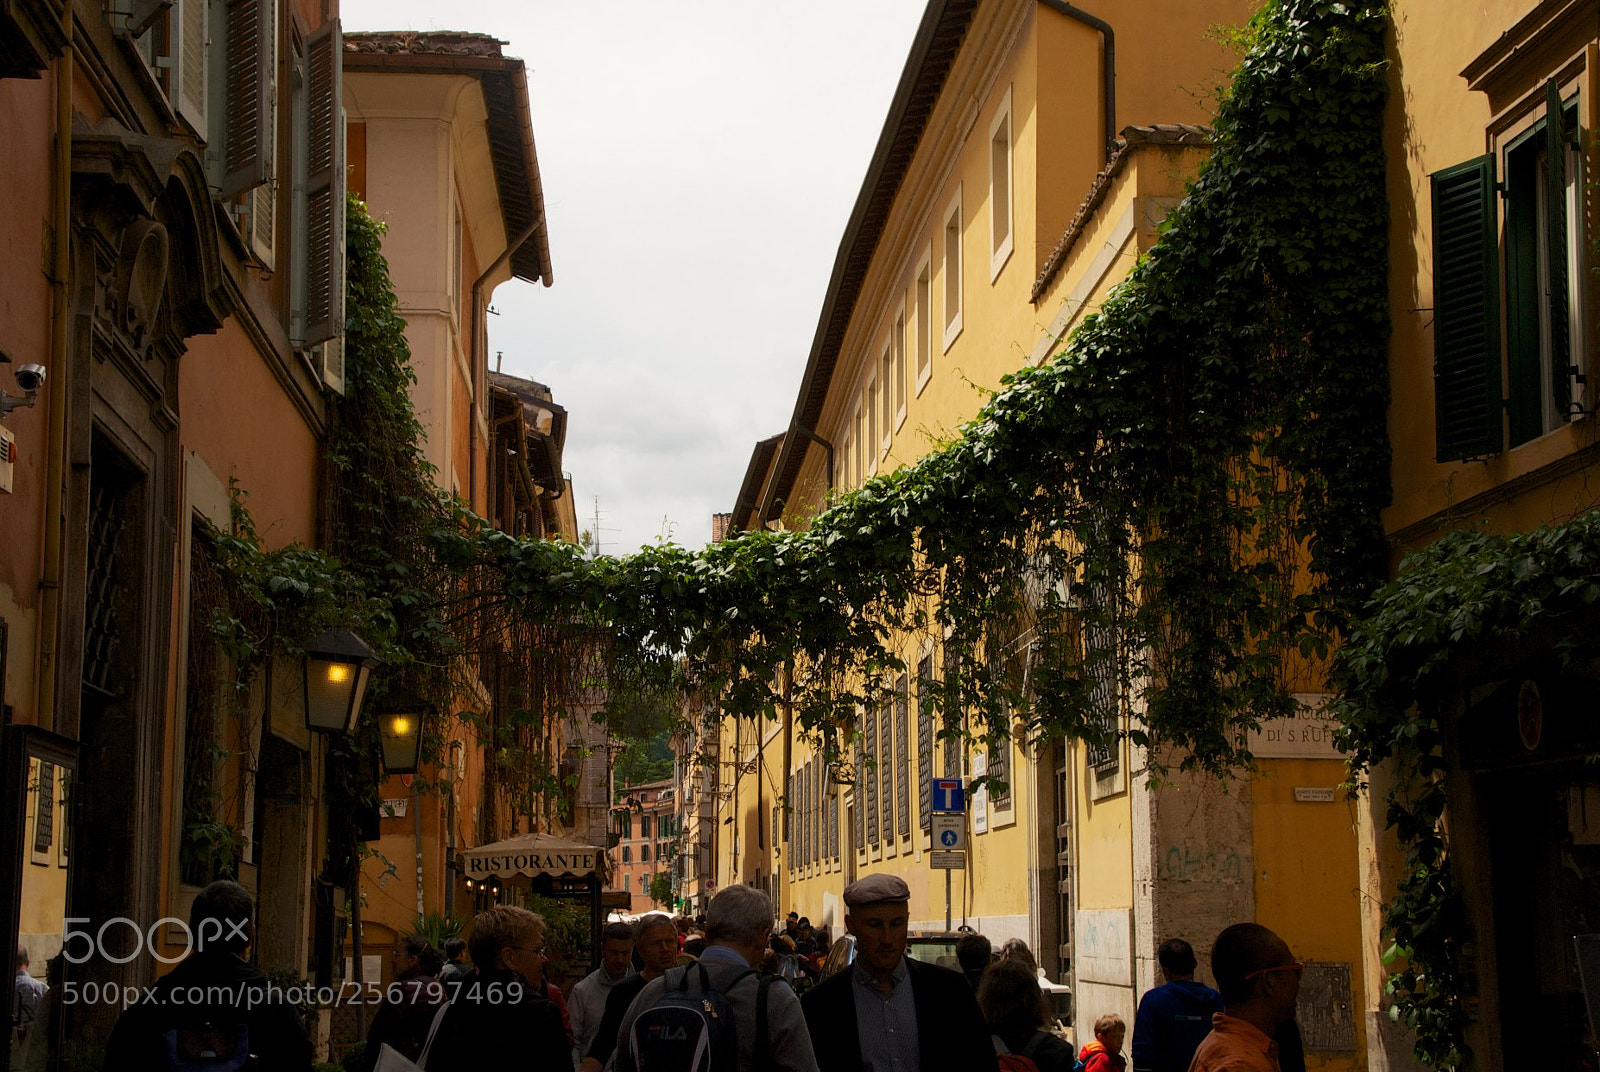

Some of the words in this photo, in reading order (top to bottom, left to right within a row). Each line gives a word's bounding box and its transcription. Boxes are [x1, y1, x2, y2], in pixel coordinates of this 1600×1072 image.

[1297, 709, 1338, 721] ICOLO
[1267, 729, 1281, 742] DI
[1287, 729, 1298, 742] S.
[1302, 729, 1335, 742] RUFI
[470, 854, 594, 873] RISTORANTE
[648, 1025, 688, 1041] FILA
